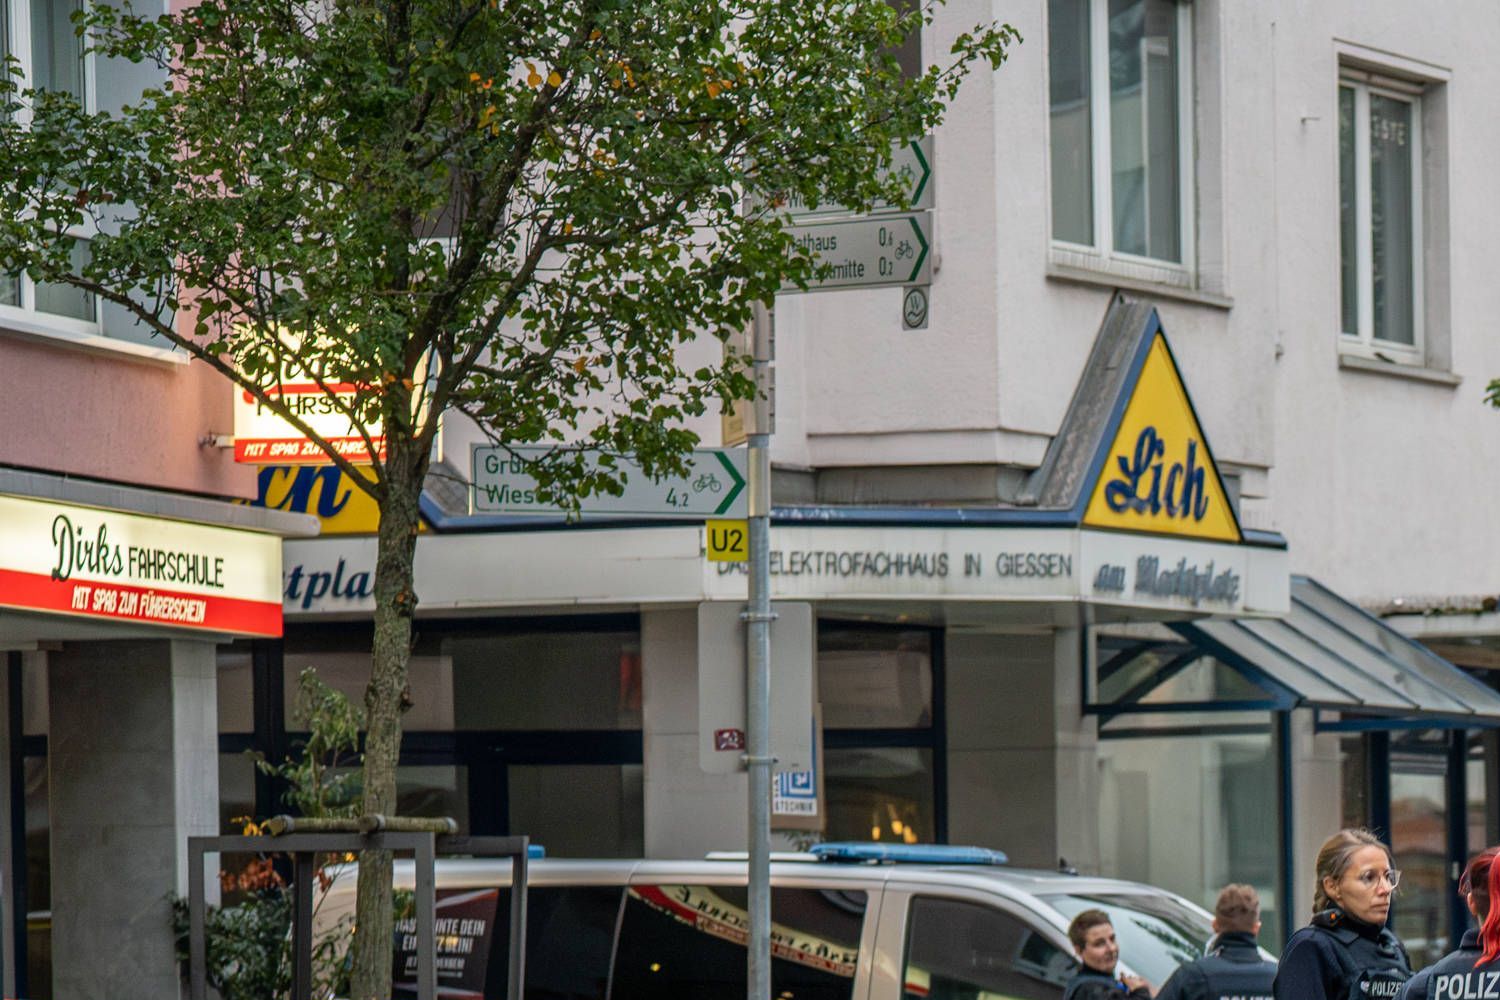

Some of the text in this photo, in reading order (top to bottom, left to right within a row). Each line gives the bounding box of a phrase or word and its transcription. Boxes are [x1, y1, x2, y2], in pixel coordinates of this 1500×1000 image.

[244, 442, 267, 457] MIT
[1104, 426, 1209, 523] Lich
[51, 513, 225, 588] Dirks FAHRSCHULE
[711, 528, 744, 553] U2
[768, 550, 949, 579] ELEKTROFACHHAUS
[964, 553, 982, 578] IN
[995, 552, 1073, 578] GIESSEN
[71, 584, 91, 611] MIT
[117, 591, 137, 616] ZUM
[138, 590, 207, 624] FÜHRERSCHEIN
